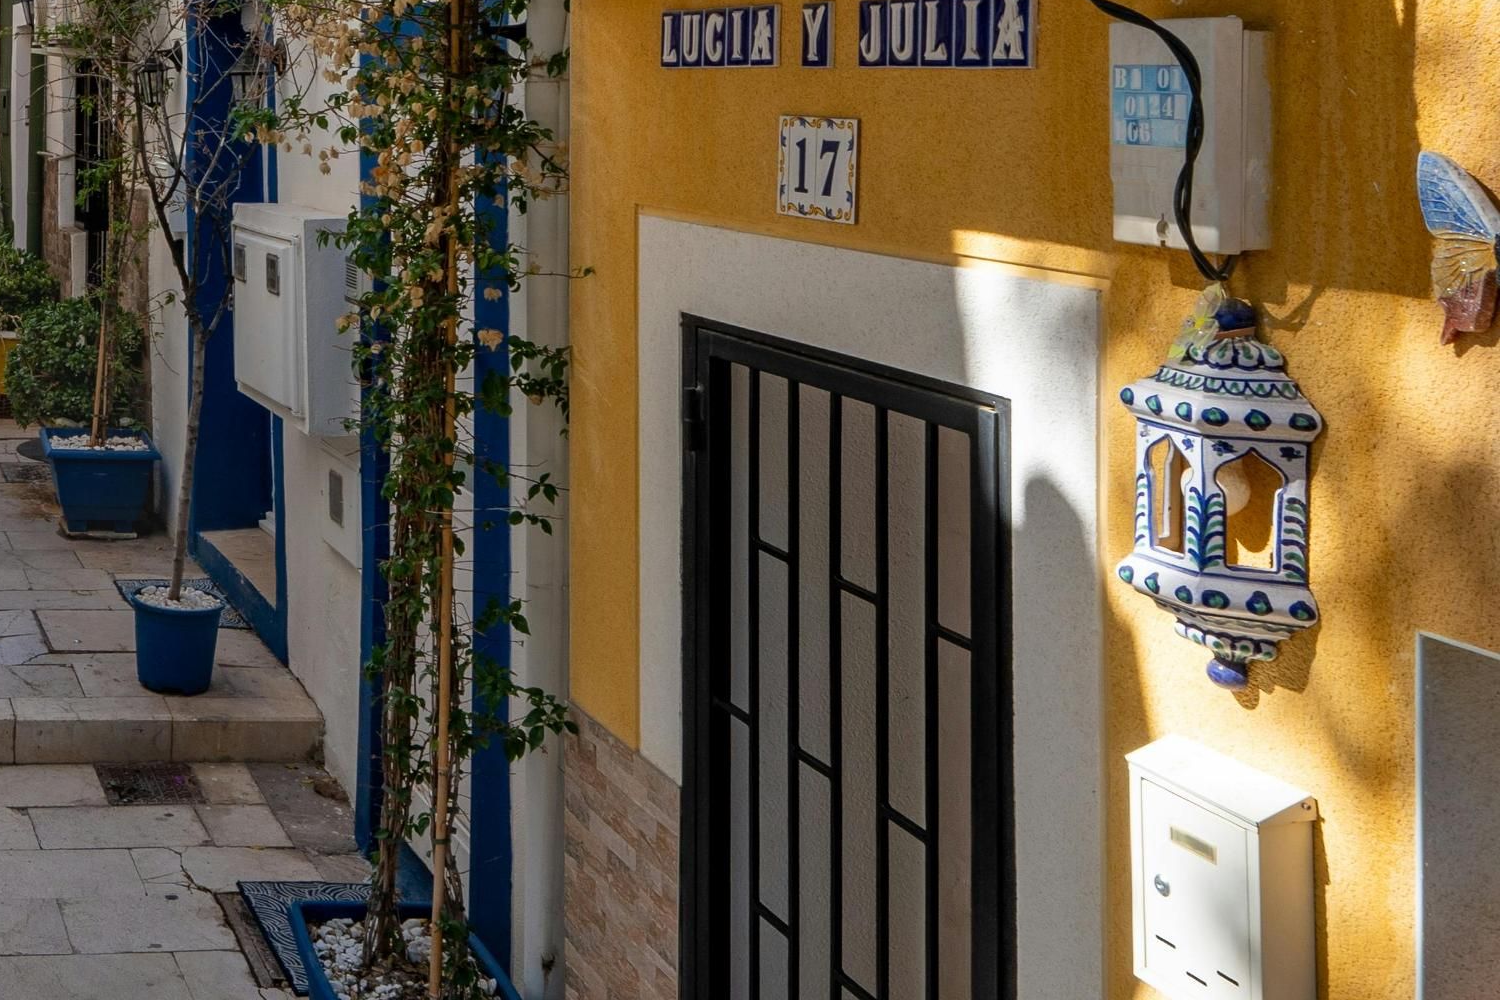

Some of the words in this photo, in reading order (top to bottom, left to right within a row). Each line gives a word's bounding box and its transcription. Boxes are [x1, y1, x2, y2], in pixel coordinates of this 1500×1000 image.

[662, 10, 772, 63] LUCIA
[802, 4, 825, 62] Y
[794, 137, 840, 197] 17
